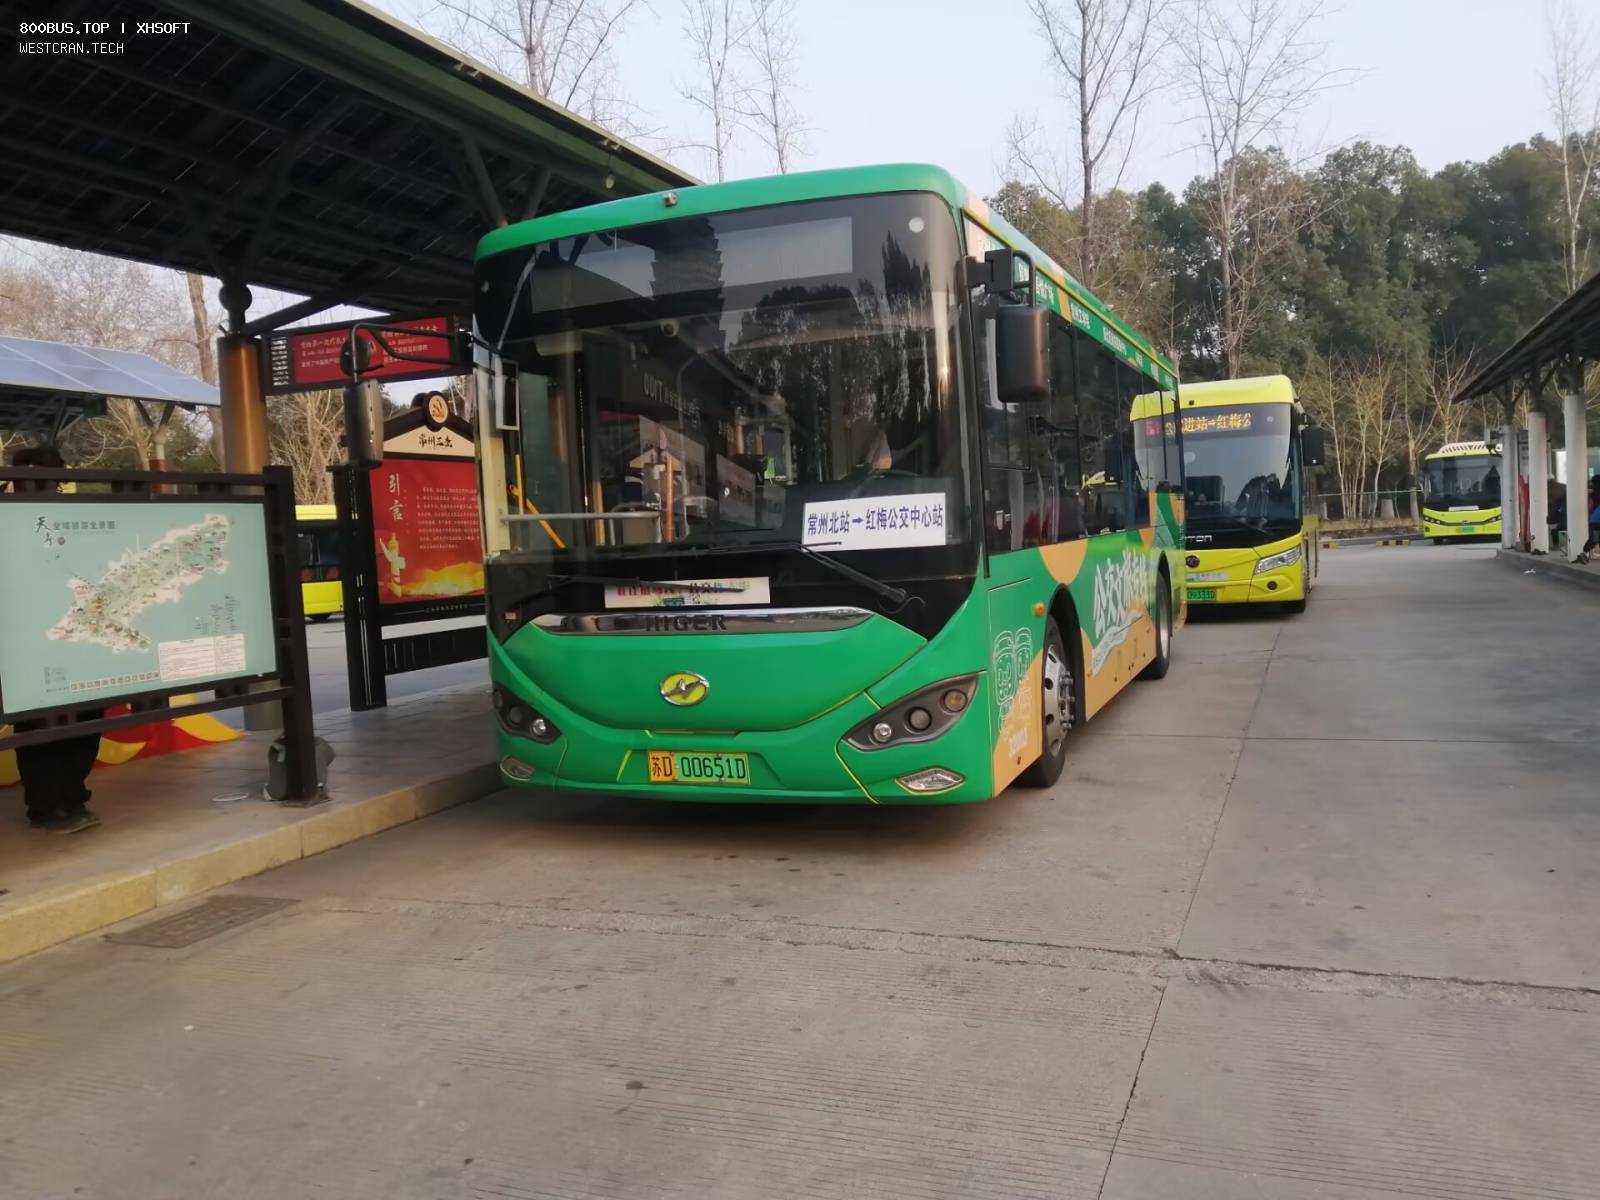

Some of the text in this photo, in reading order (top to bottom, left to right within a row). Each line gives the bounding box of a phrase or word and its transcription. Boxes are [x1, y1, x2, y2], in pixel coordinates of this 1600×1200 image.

[807, 503, 944, 536] 常州北站 红梅公交中心站
[652, 756, 746, 779] 苏D 00651D
